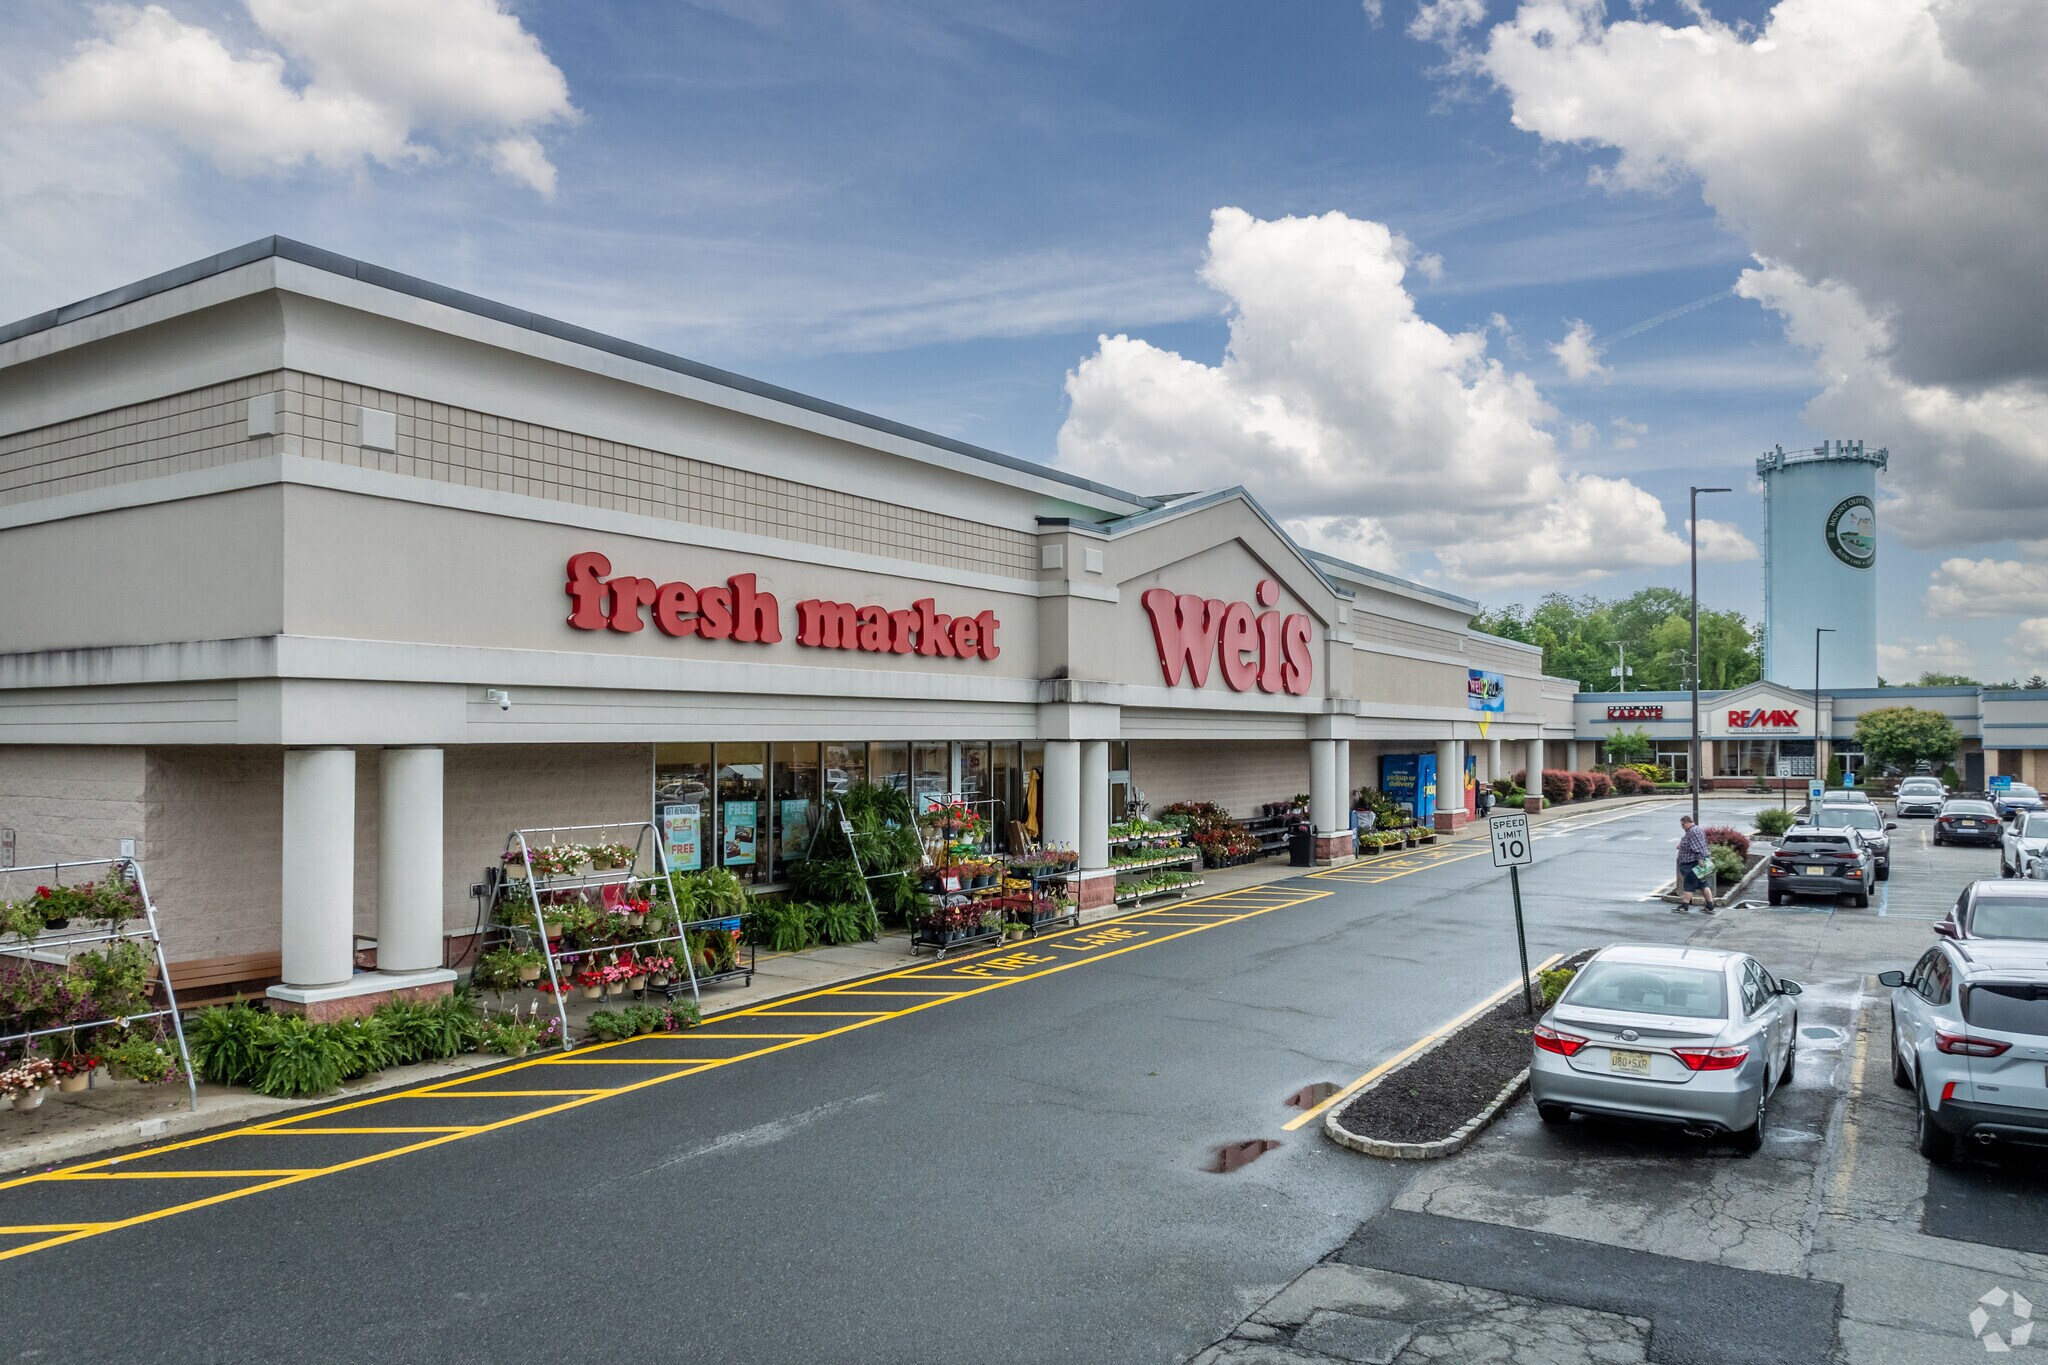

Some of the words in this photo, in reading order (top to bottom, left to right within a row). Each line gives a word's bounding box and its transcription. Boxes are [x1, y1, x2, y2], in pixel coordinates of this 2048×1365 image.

[1829, 503, 1848, 527] MOUNT
[1847, 498, 1865, 506] OLIVE
[565, 551, 783, 644] fresh
[796, 598, 1001, 660] market
[1608, 709, 1663, 719] KARATE
[1728, 708, 1799, 728] RE/MAX
[728, 803, 753, 815] FREE
[1493, 819, 1525, 829] SPEED
[1497, 830, 1522, 839] LIMIT
[672, 843, 694, 855] FREE
[1500, 840, 1524, 859] 10
[952, 952, 1058, 976] FIRE
[1049, 927, 1149, 951] LANE
